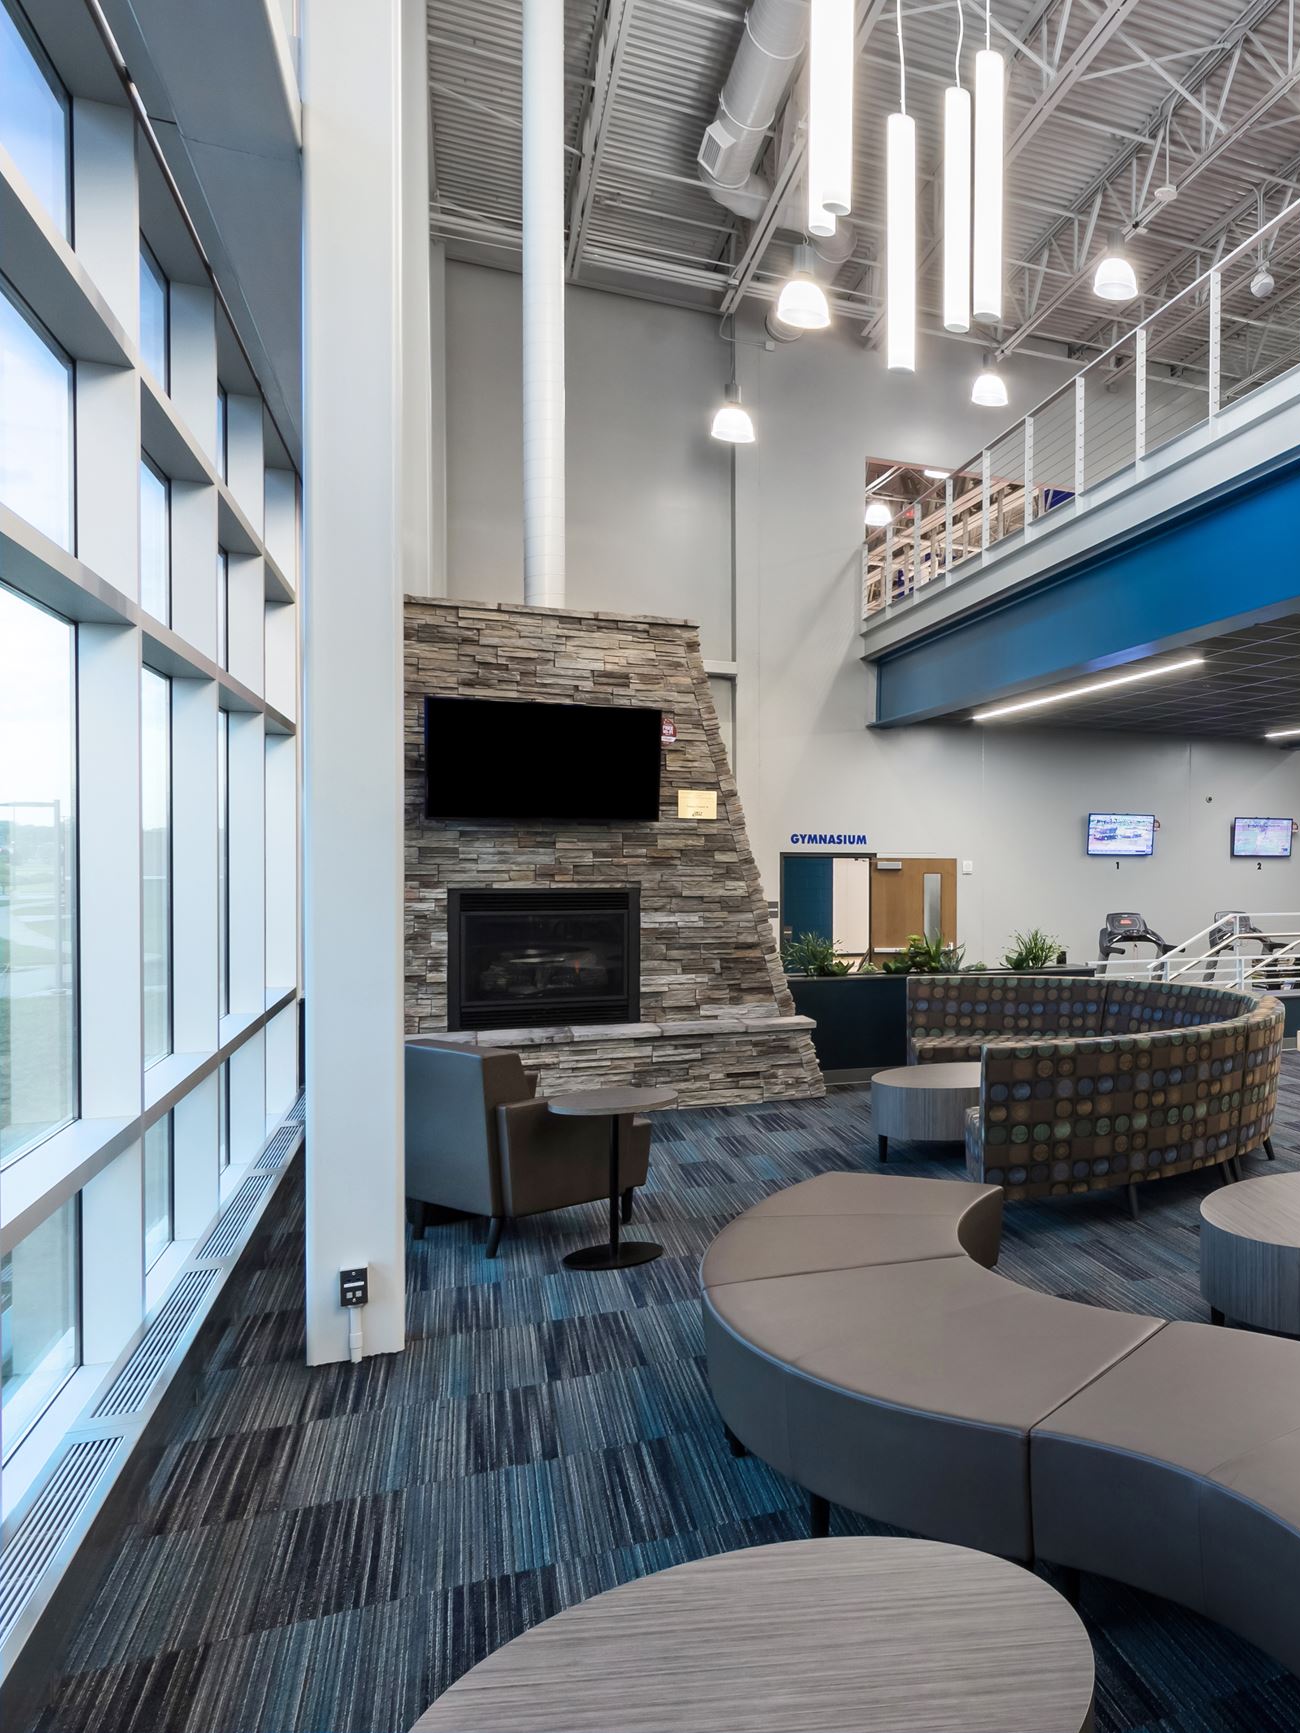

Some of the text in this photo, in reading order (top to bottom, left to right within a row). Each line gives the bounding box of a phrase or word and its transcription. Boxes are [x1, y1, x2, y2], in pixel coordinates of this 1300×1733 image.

[790, 833, 868, 845] GYMNASIUM
[1115, 861, 1119, 870] 1
[1256, 862, 1262, 870] 2
